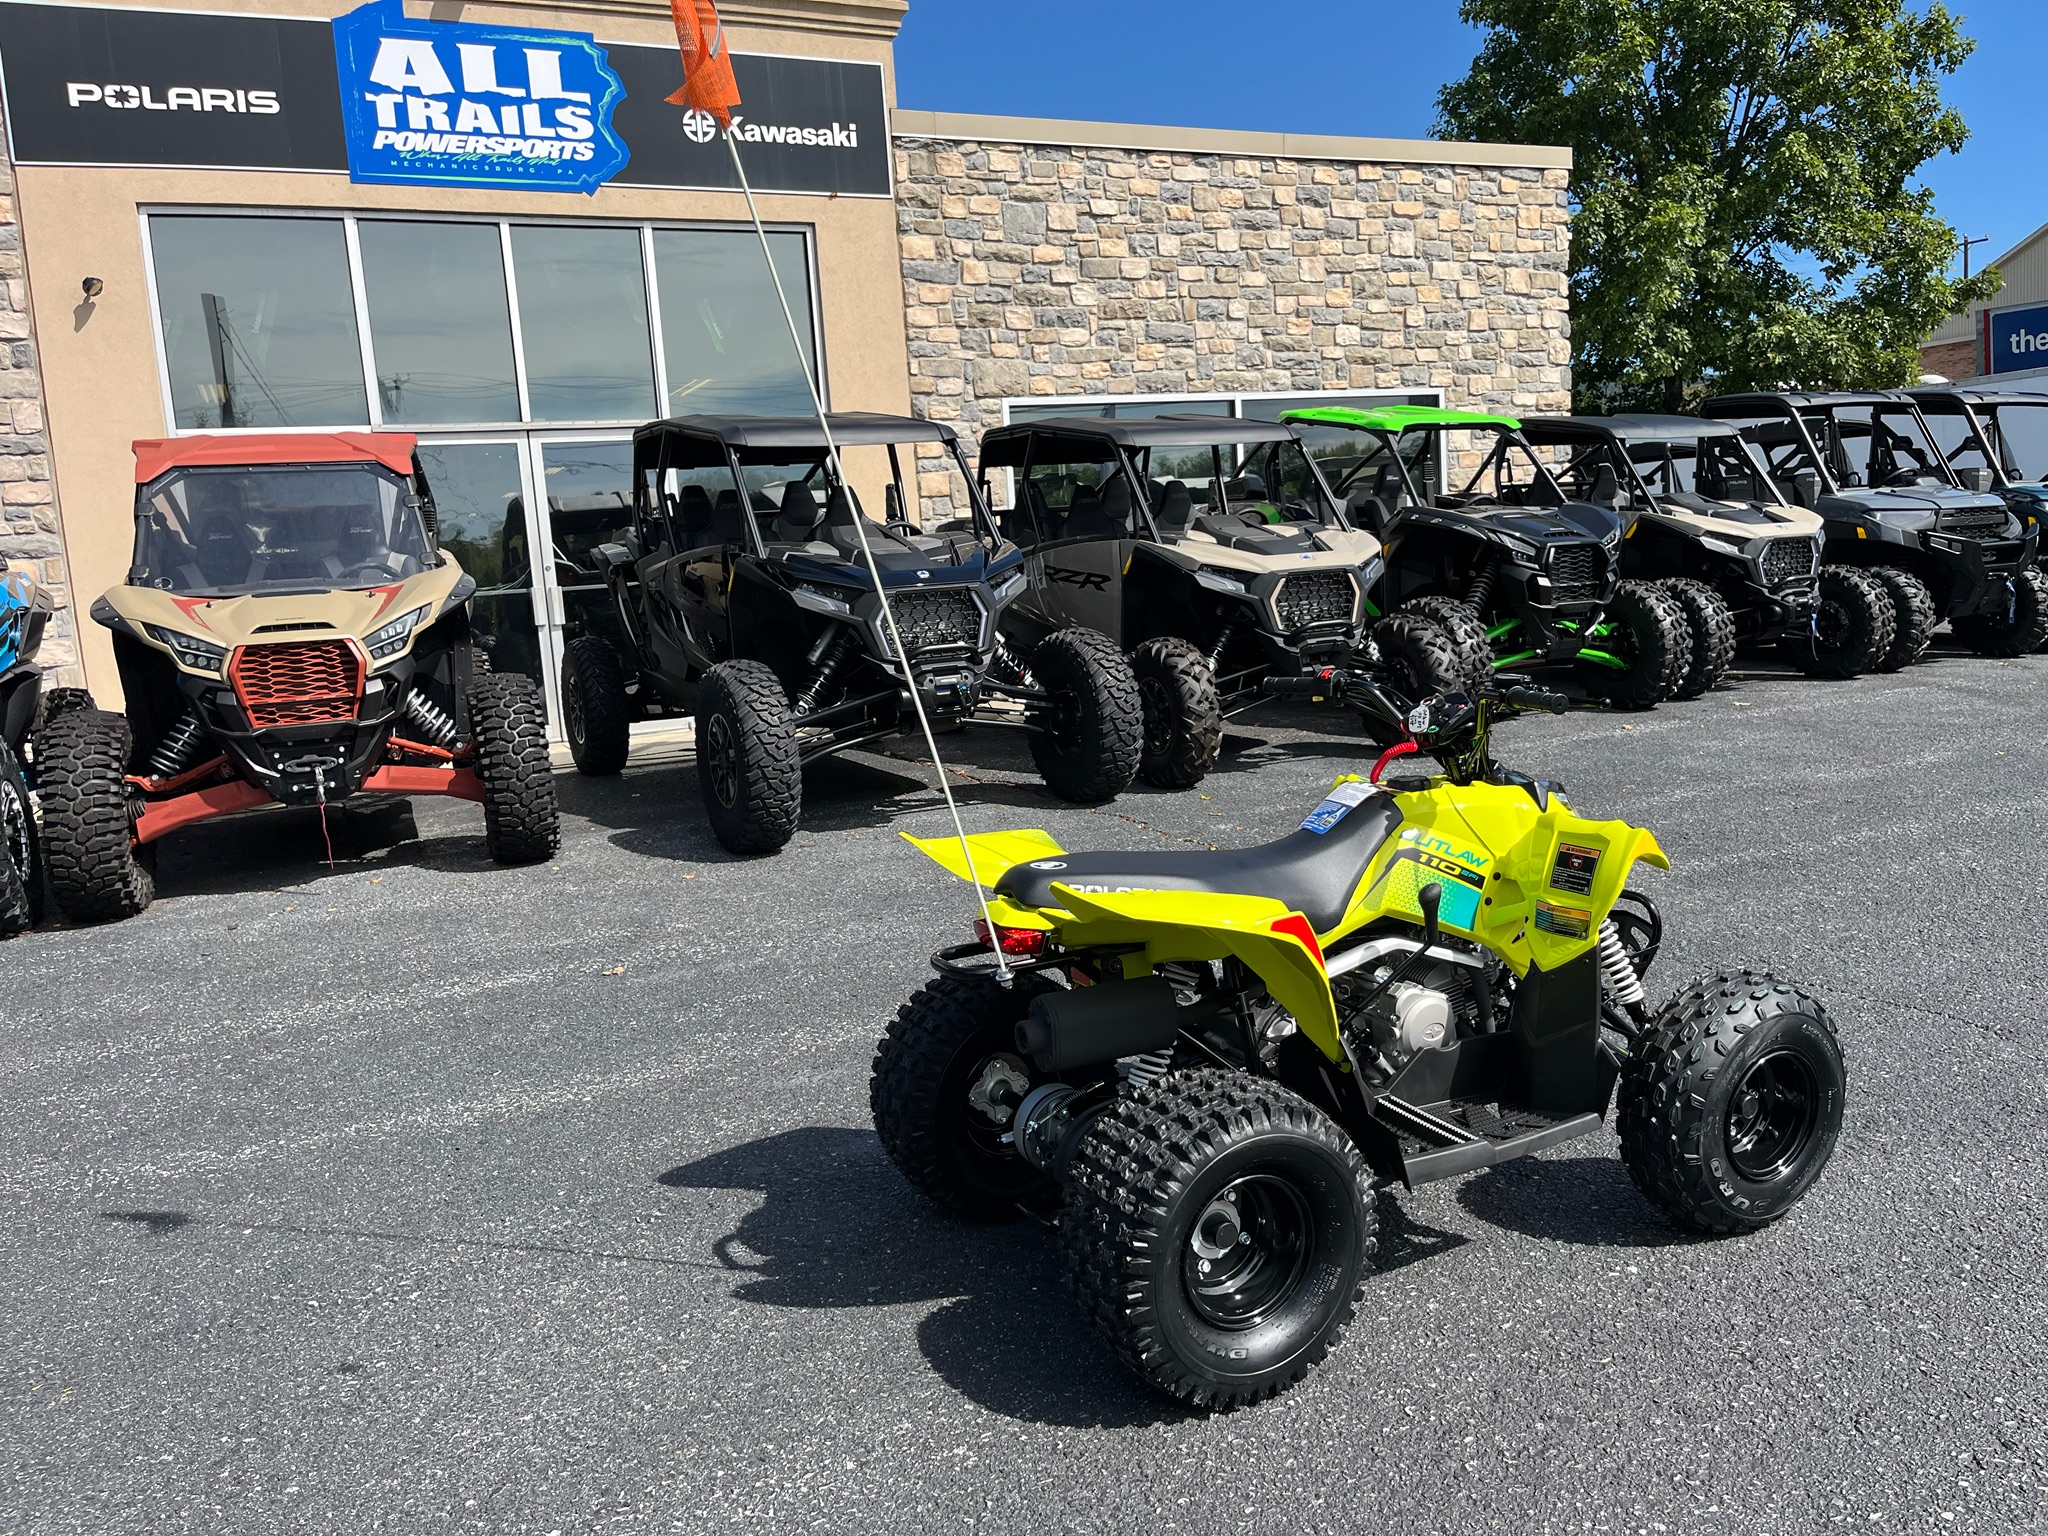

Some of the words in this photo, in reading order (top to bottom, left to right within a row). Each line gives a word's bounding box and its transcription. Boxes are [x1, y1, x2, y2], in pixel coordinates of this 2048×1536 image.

[369, 38, 591, 106] ALL
[66, 82, 280, 114] POLARIS
[364, 92, 595, 140] TRAILS
[722, 115, 858, 148] Kawasaki
[373, 130, 595, 161] POWERSPORTS
[398, 150, 449, 160] Where
[452, 151, 480, 162] All
[485, 153, 526, 165] Trails
[2010, 328, 2048, 354] the
[1038, 564, 1112, 593] RZR
[1419, 853, 1461, 876] 110
